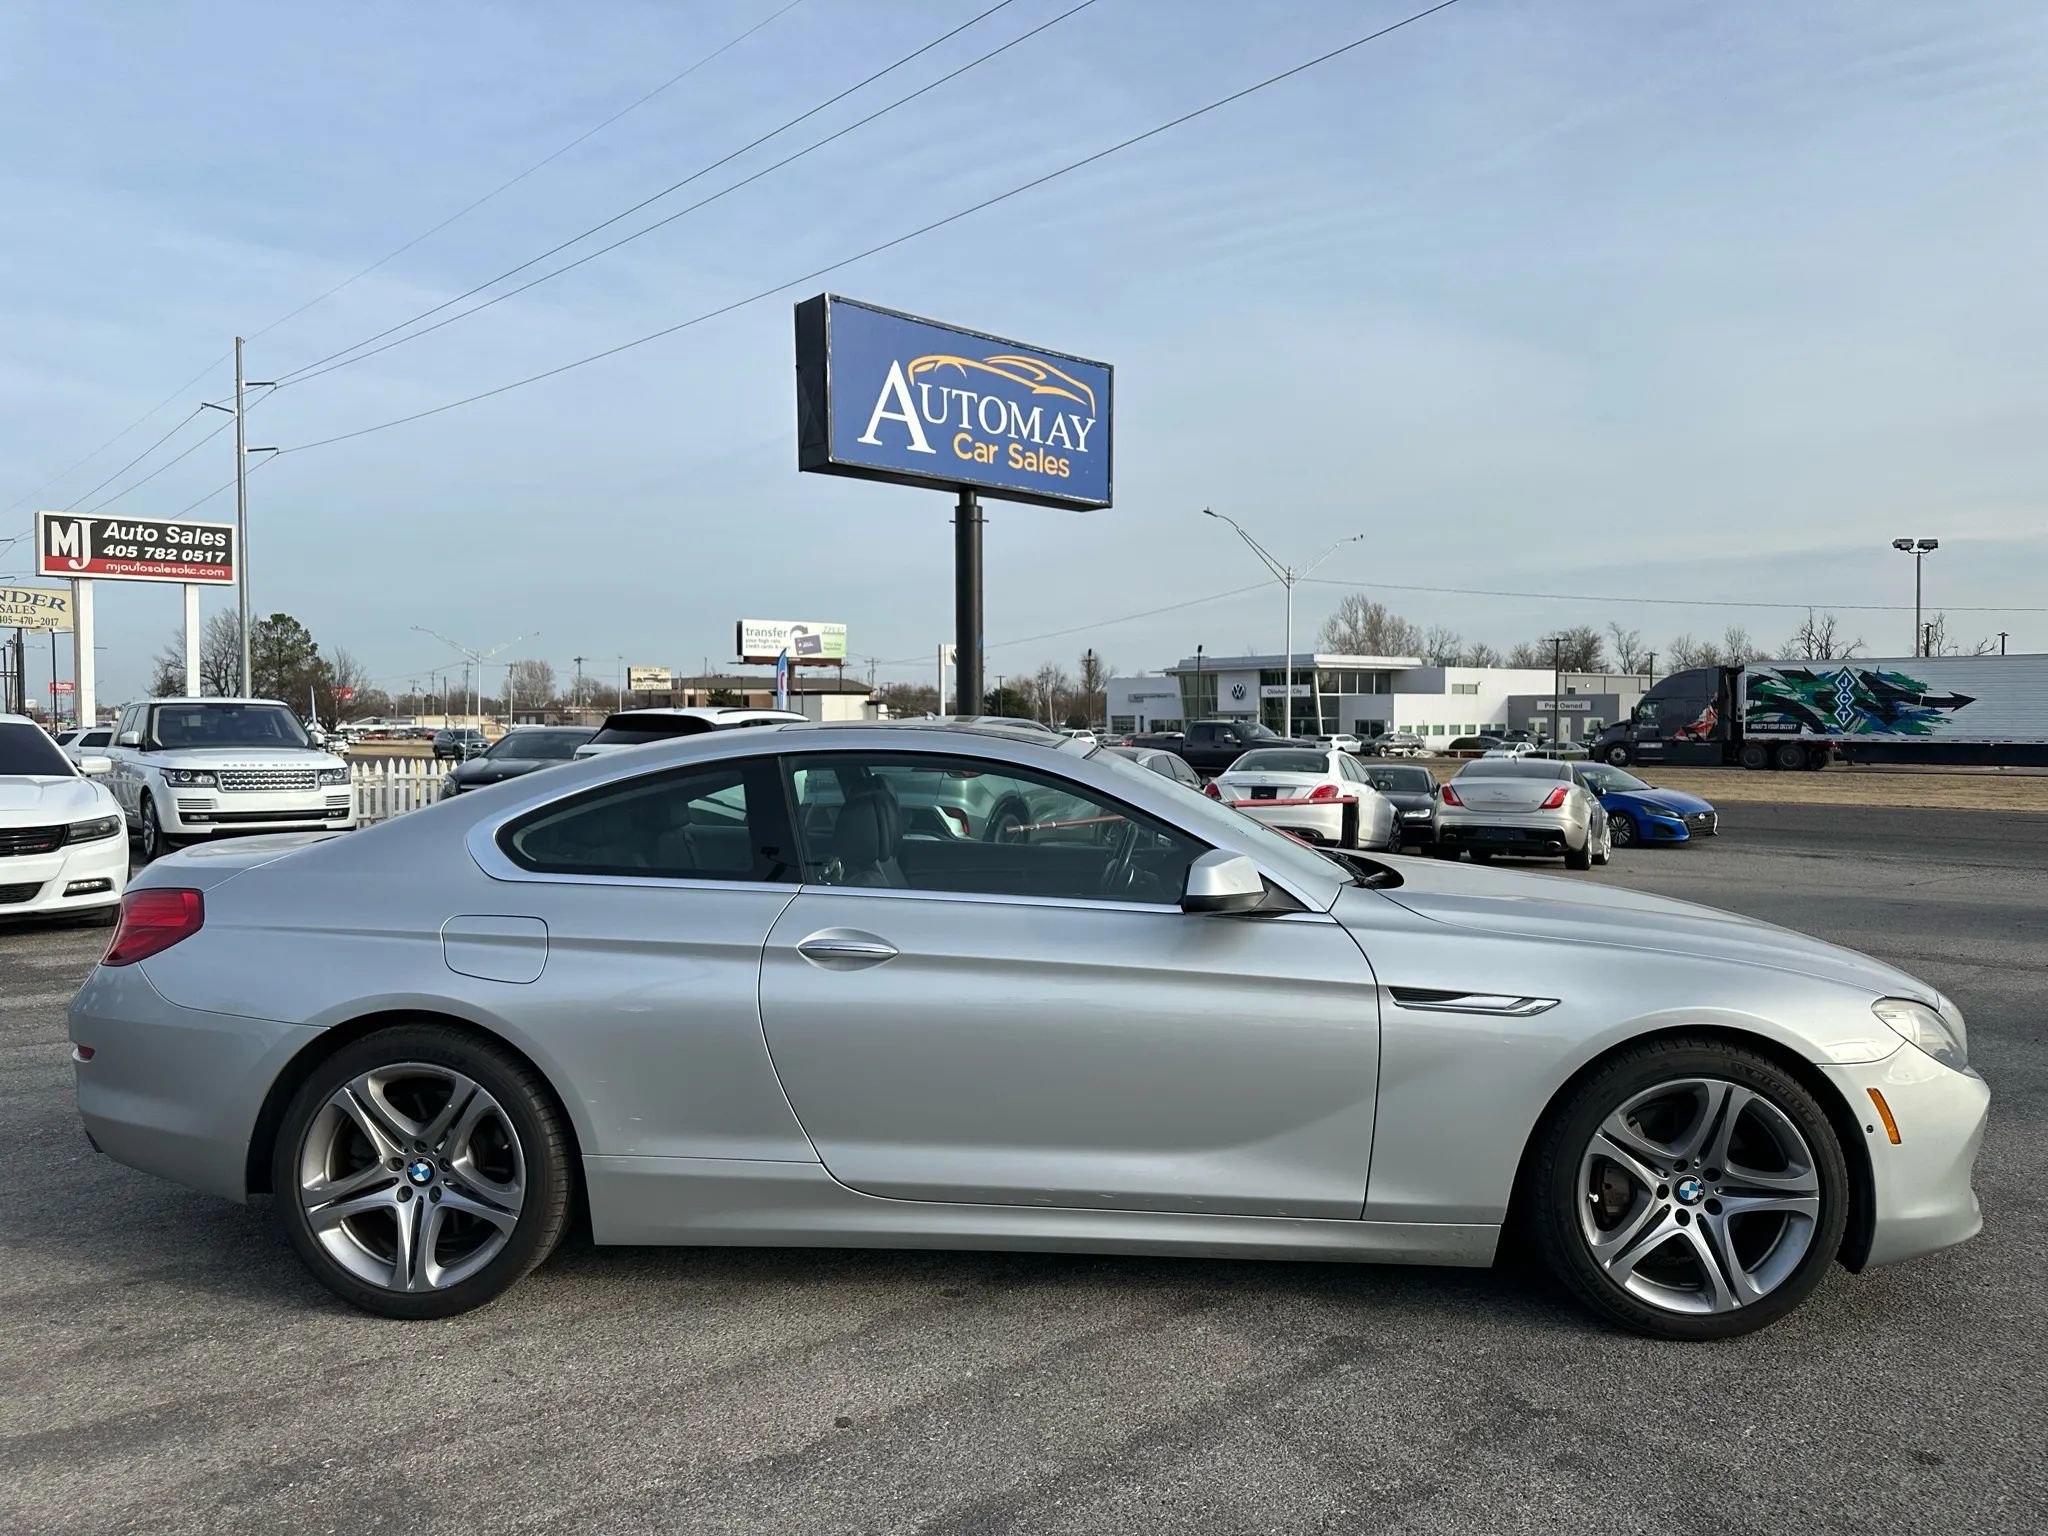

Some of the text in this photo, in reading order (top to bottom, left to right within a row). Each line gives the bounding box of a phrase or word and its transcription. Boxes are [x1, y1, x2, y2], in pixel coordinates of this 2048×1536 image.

[857, 360, 1096, 454] AUTOMAY
[953, 432, 1070, 478] Car Sales
[50, 519, 98, 570] MJ
[103, 521, 227, 547] Auto Sales
[103, 544, 226, 564] 405 782 0517
[105, 562, 225, 577] mjautosalesokc.com
[745, 627, 788, 638] transfer
